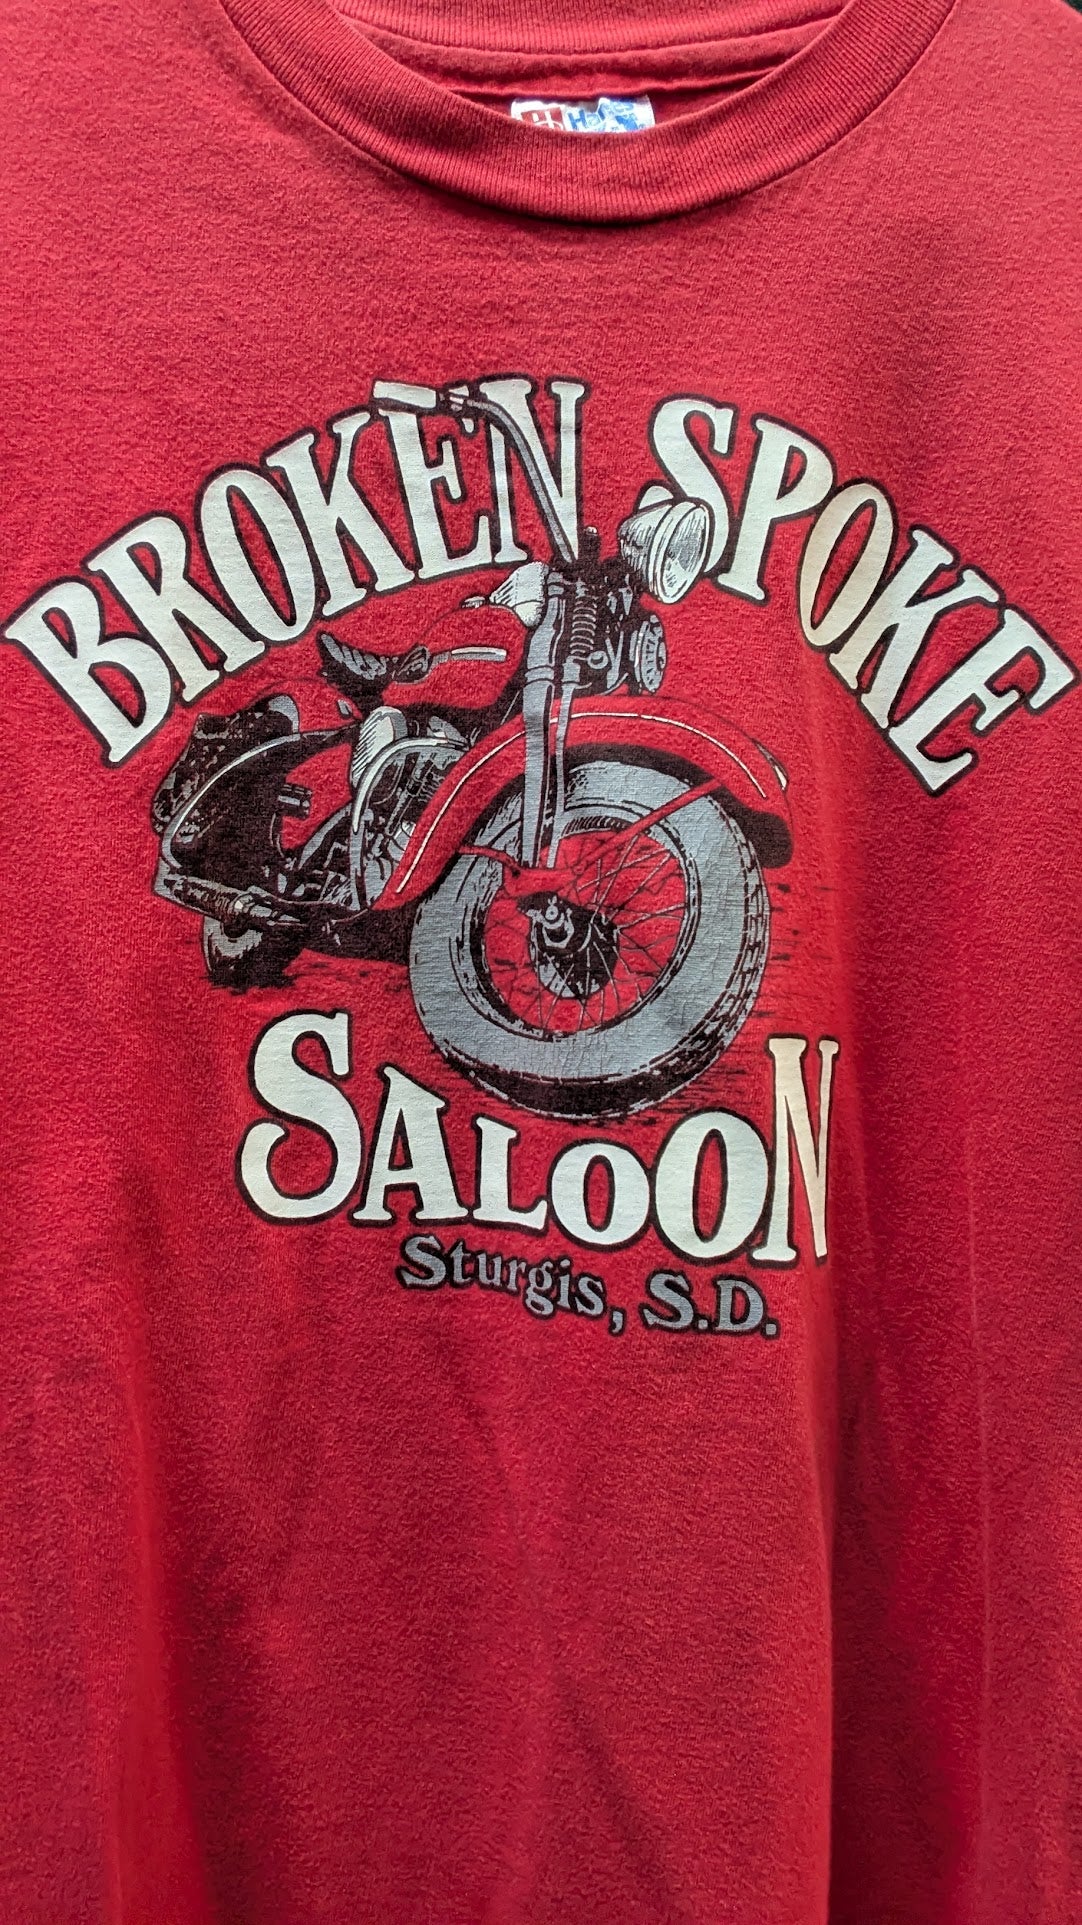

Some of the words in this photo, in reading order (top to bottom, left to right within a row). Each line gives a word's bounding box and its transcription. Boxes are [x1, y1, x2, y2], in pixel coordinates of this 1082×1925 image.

[4, 375, 591, 765] BROKEN
[637, 395, 1079, 796] SPOKE
[236, 1009, 840, 1267] SALOON
[399, 1234, 624, 1335] Sturgis,
[641, 1270, 779, 1337] S.D.
